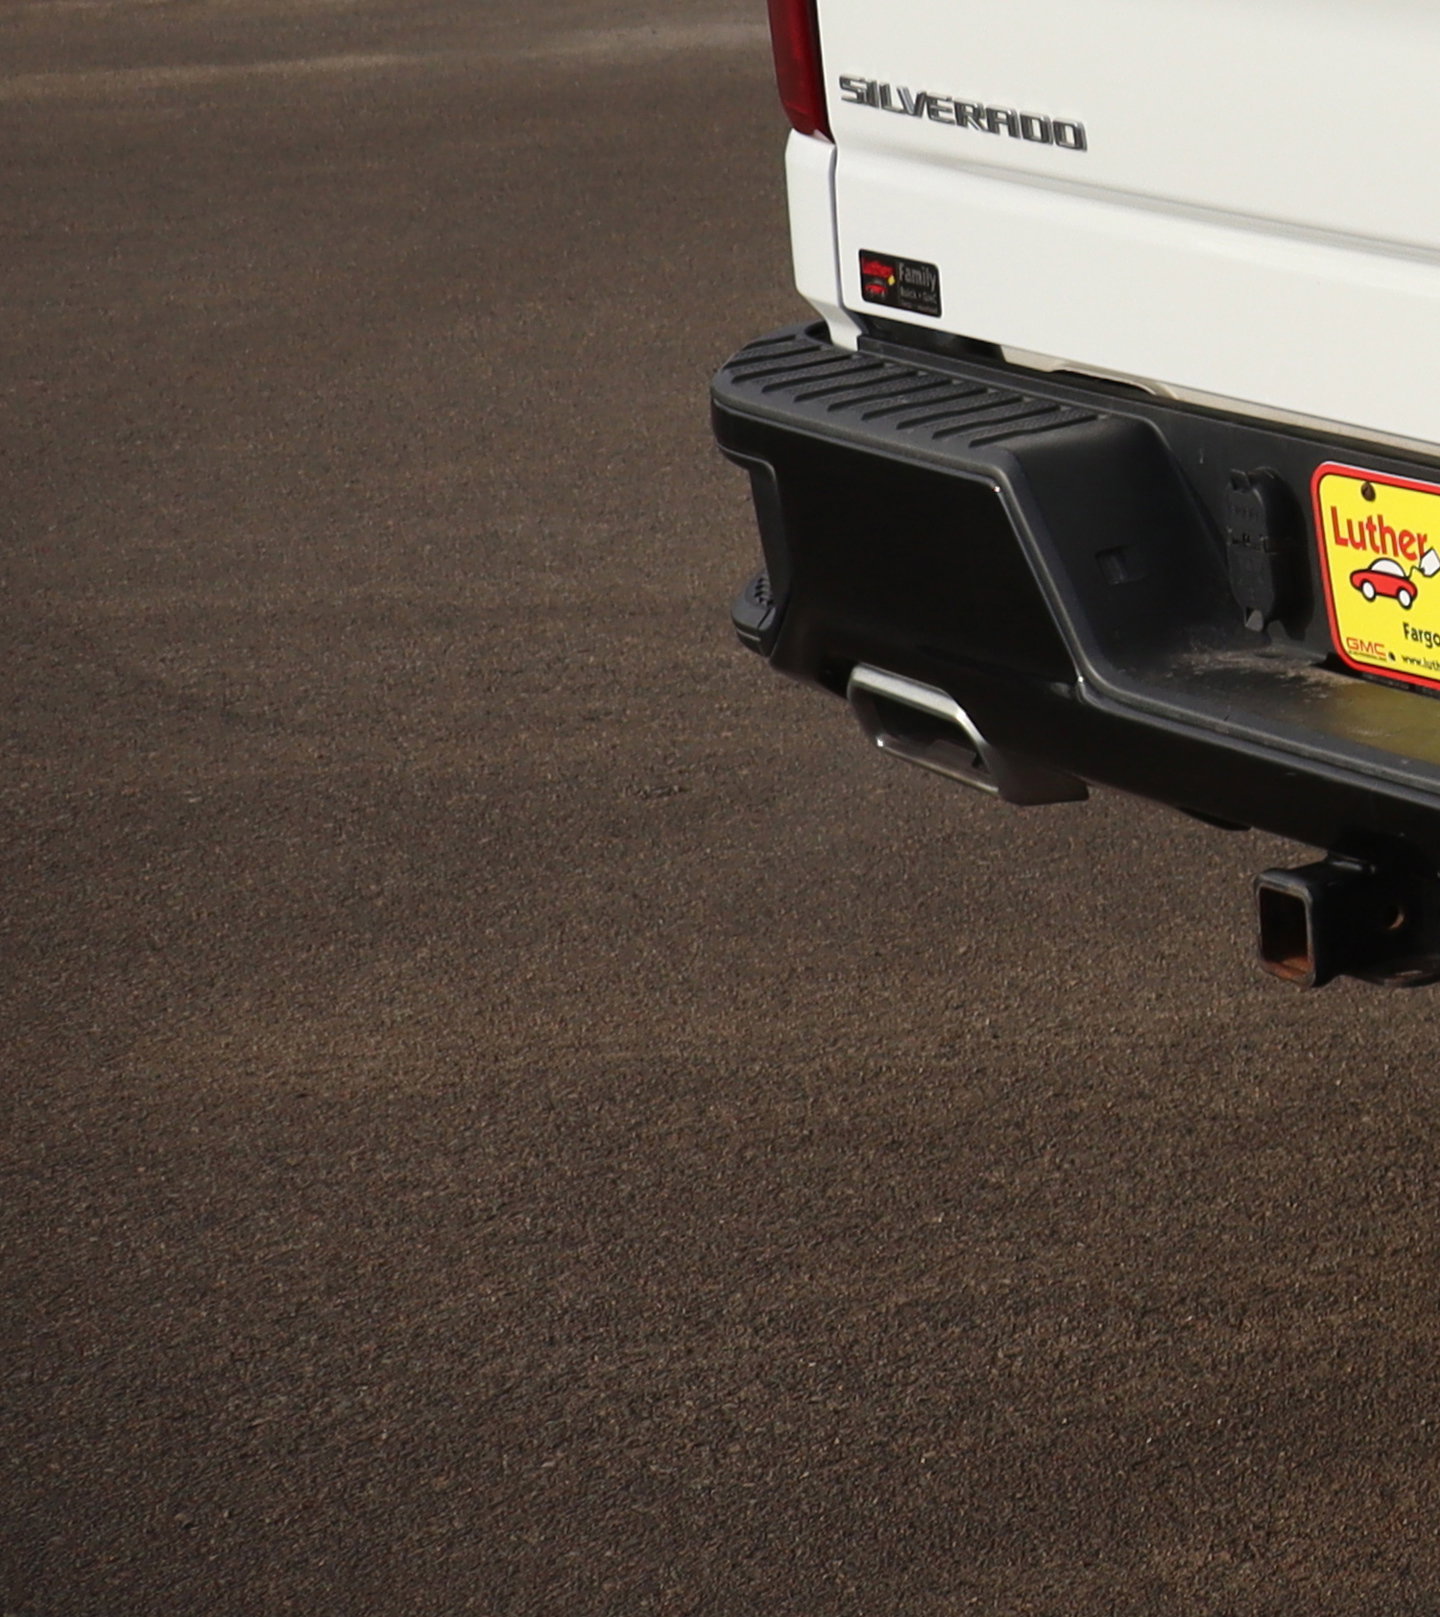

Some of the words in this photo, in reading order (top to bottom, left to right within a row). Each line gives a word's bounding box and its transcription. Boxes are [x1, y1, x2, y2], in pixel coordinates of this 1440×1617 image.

[839, 74, 1088, 152] SILVERADO
[1330, 506, 1428, 562] Luther
[1346, 636, 1386, 656] GMC
